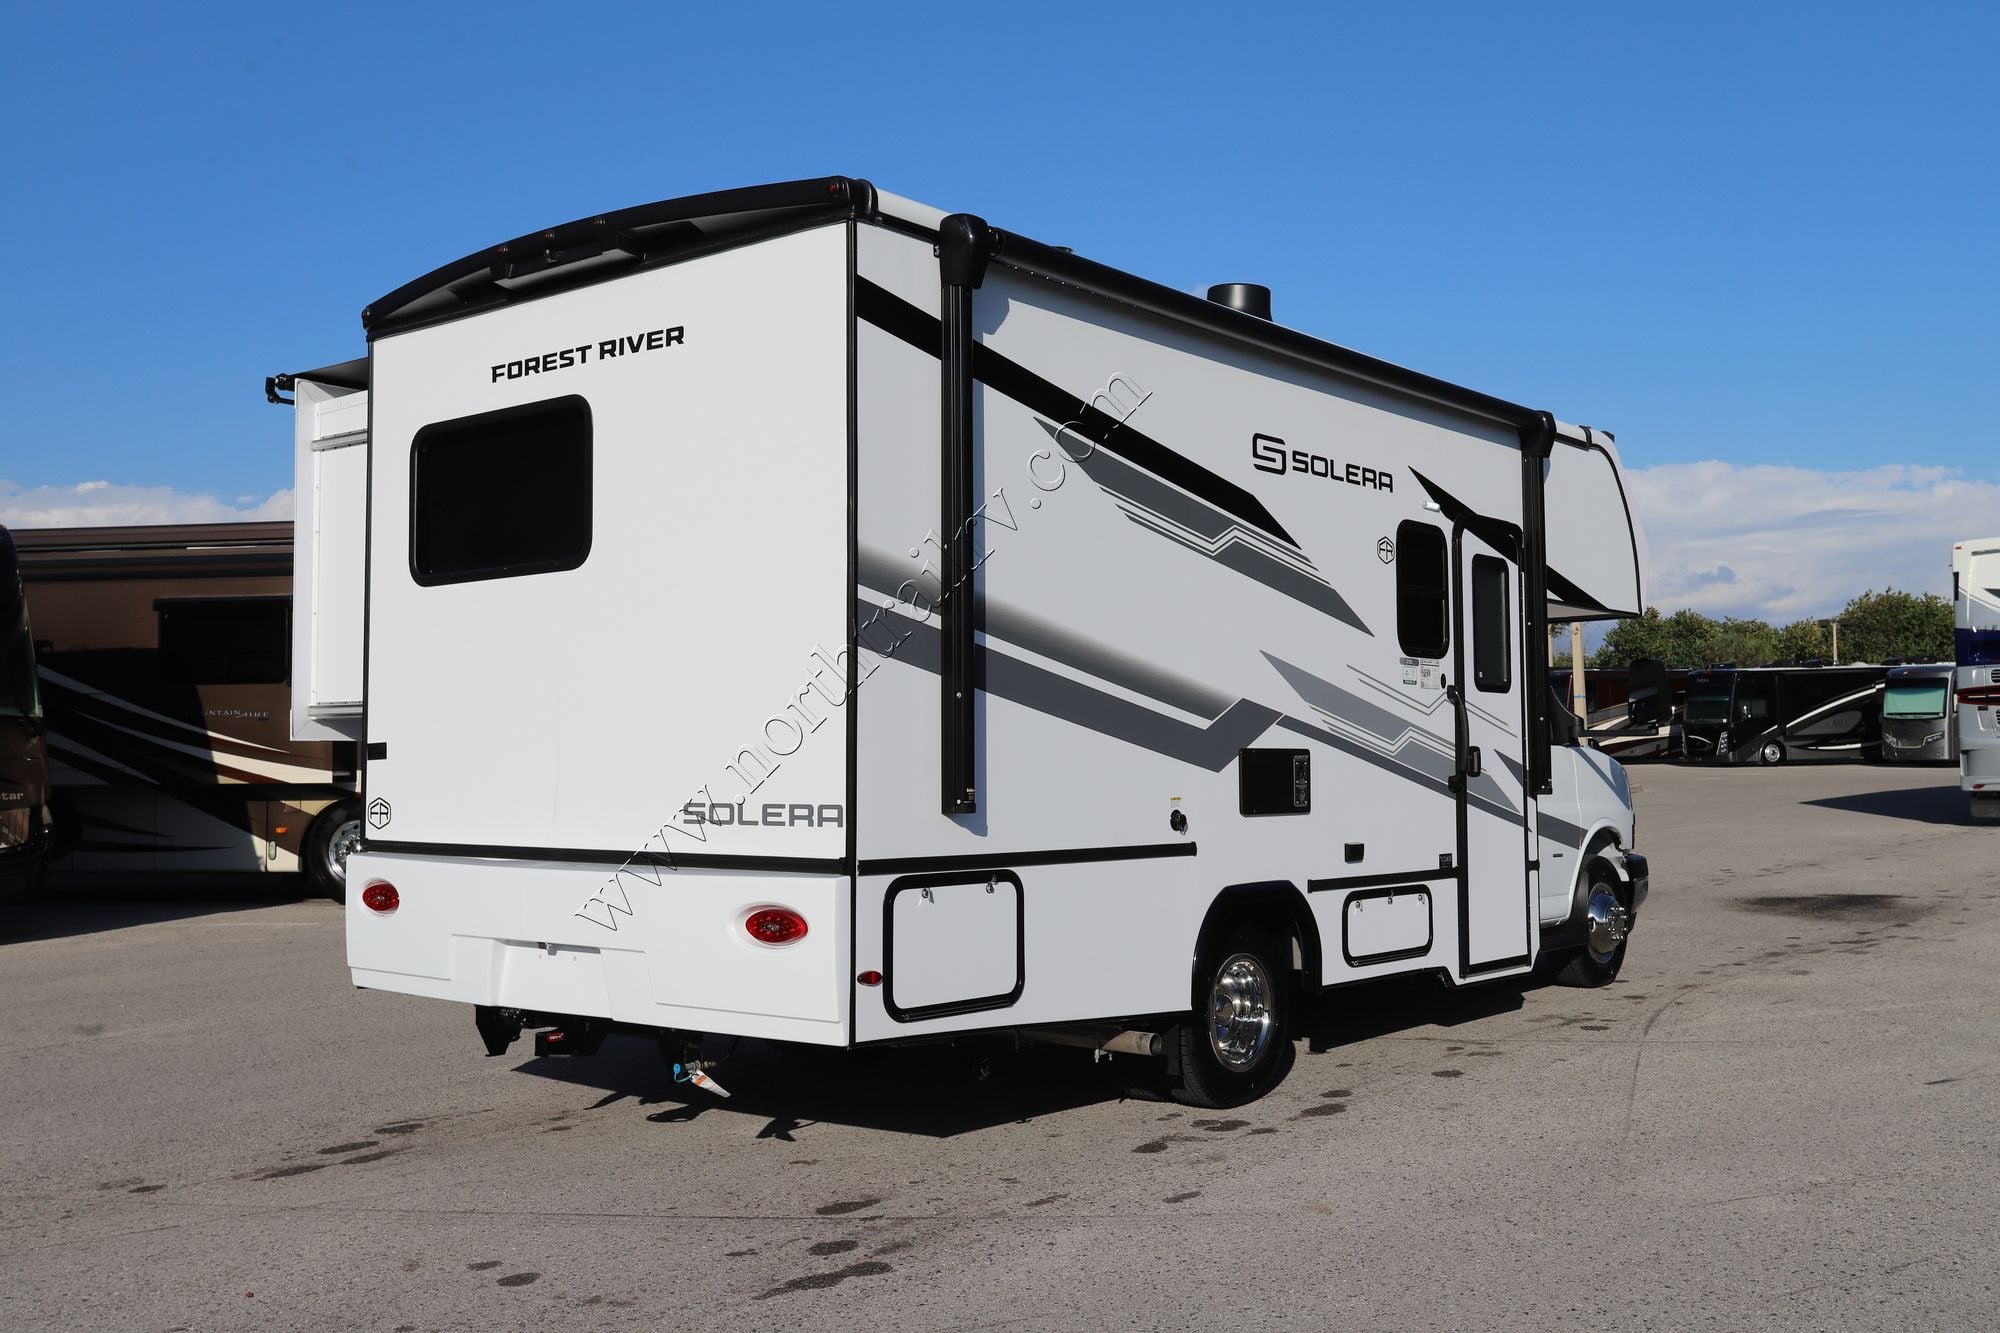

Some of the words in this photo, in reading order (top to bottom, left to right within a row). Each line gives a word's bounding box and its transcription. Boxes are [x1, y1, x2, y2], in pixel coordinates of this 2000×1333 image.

[491, 344, 593, 384] FOREST
[598, 325, 685, 361] RIVER
[1292, 450, 1394, 494] SOLERA
[0, 791, 24, 801] tar
[683, 802, 844, 828] SOLERA
